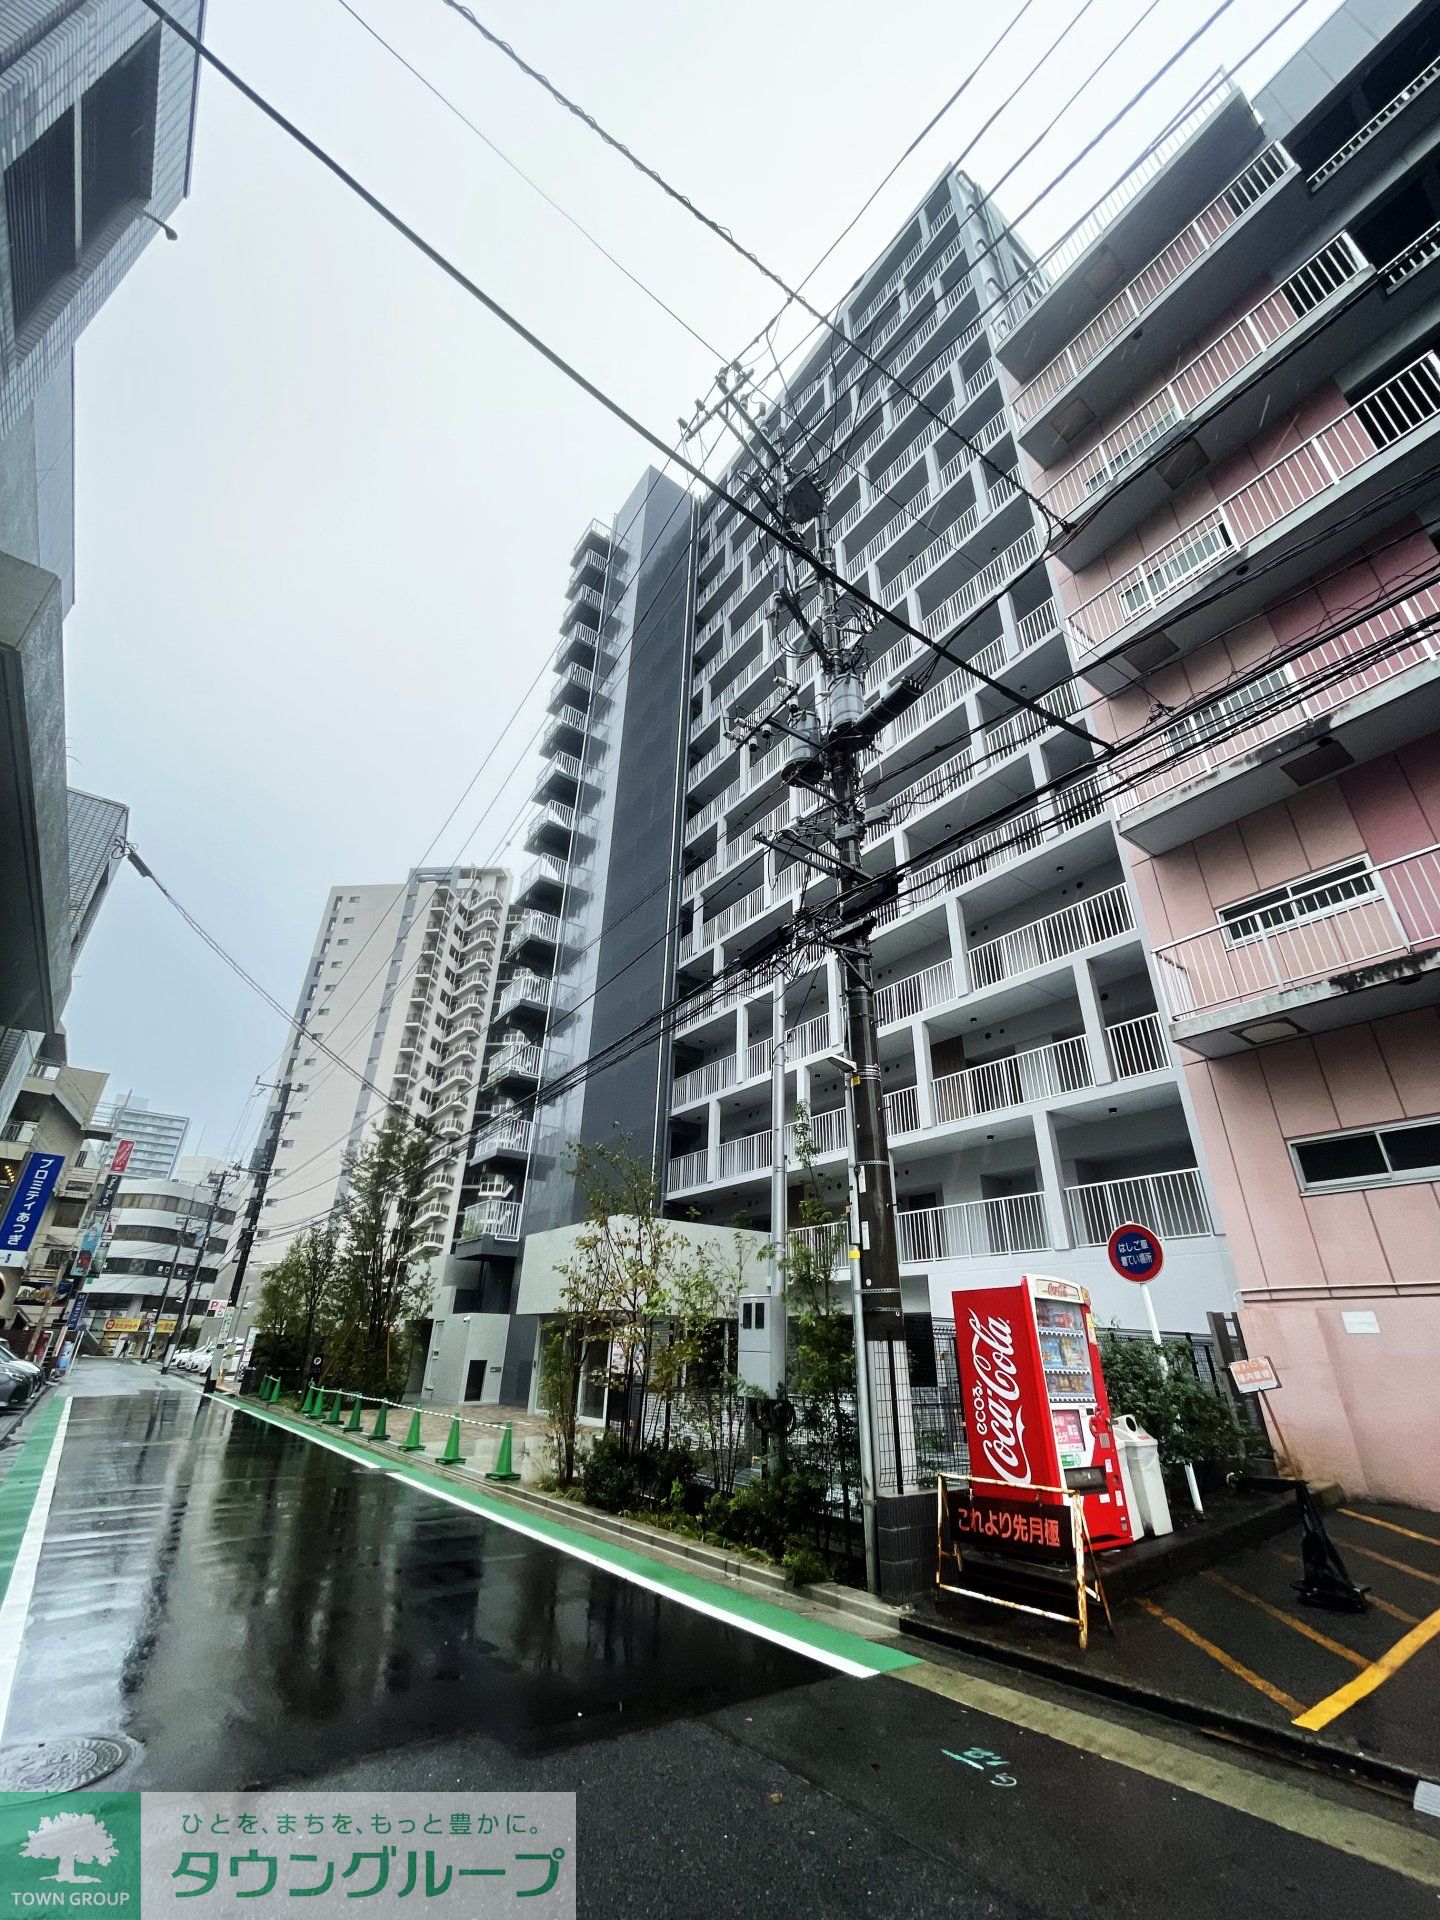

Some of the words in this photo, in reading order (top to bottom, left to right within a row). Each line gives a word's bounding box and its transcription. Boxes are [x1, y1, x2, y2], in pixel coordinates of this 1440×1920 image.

[7, 1159, 54, 1246] プロミティあつぎ
[1118, 1239, 1149, 1253] はしご車
[968, 1308, 1031, 1485] Coca-Cola
[958, 1507, 1060, 1547] これより先月極
